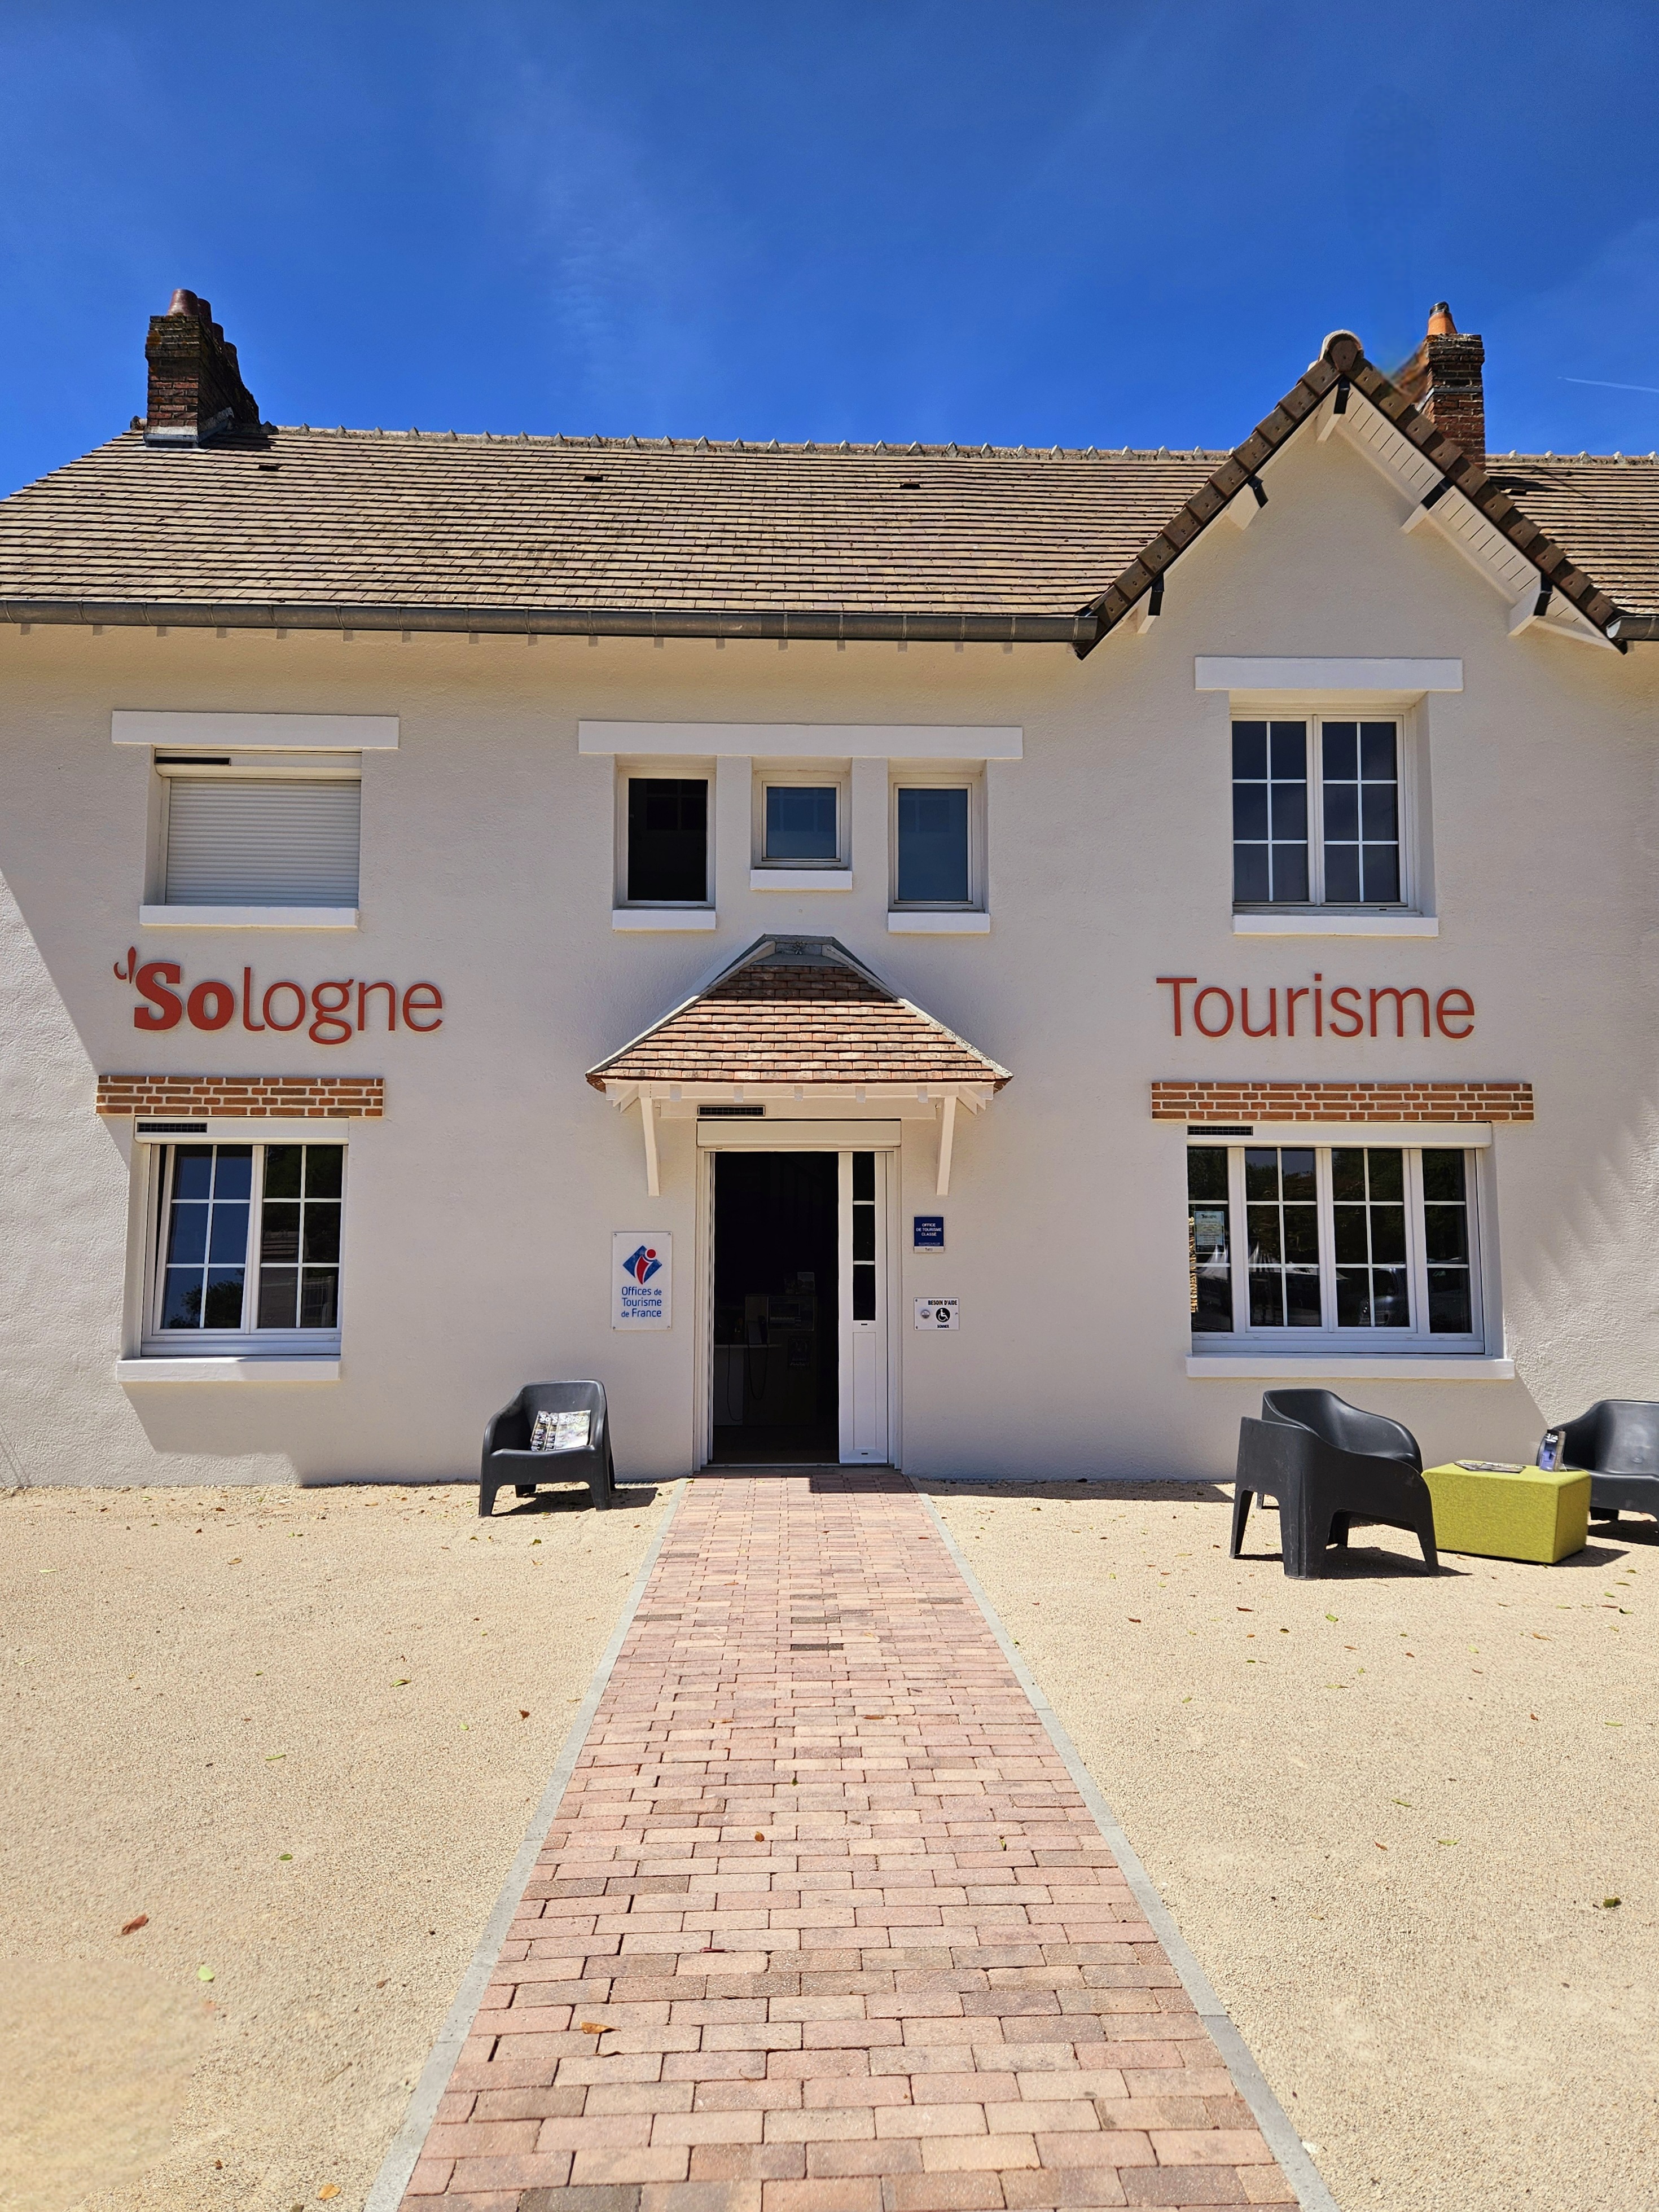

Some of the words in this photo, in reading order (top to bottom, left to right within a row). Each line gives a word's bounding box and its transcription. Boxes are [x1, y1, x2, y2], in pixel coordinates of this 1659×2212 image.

[133, 961, 444, 1045] Sologne
[1156, 973, 1475, 1039] Tourisme
[622, 1287, 651, 1296] Offices
[621, 1297, 662, 1306] Tourisme
[632, 1308, 662, 1317] France
[560, 1415, 589, 1423] Sologne
